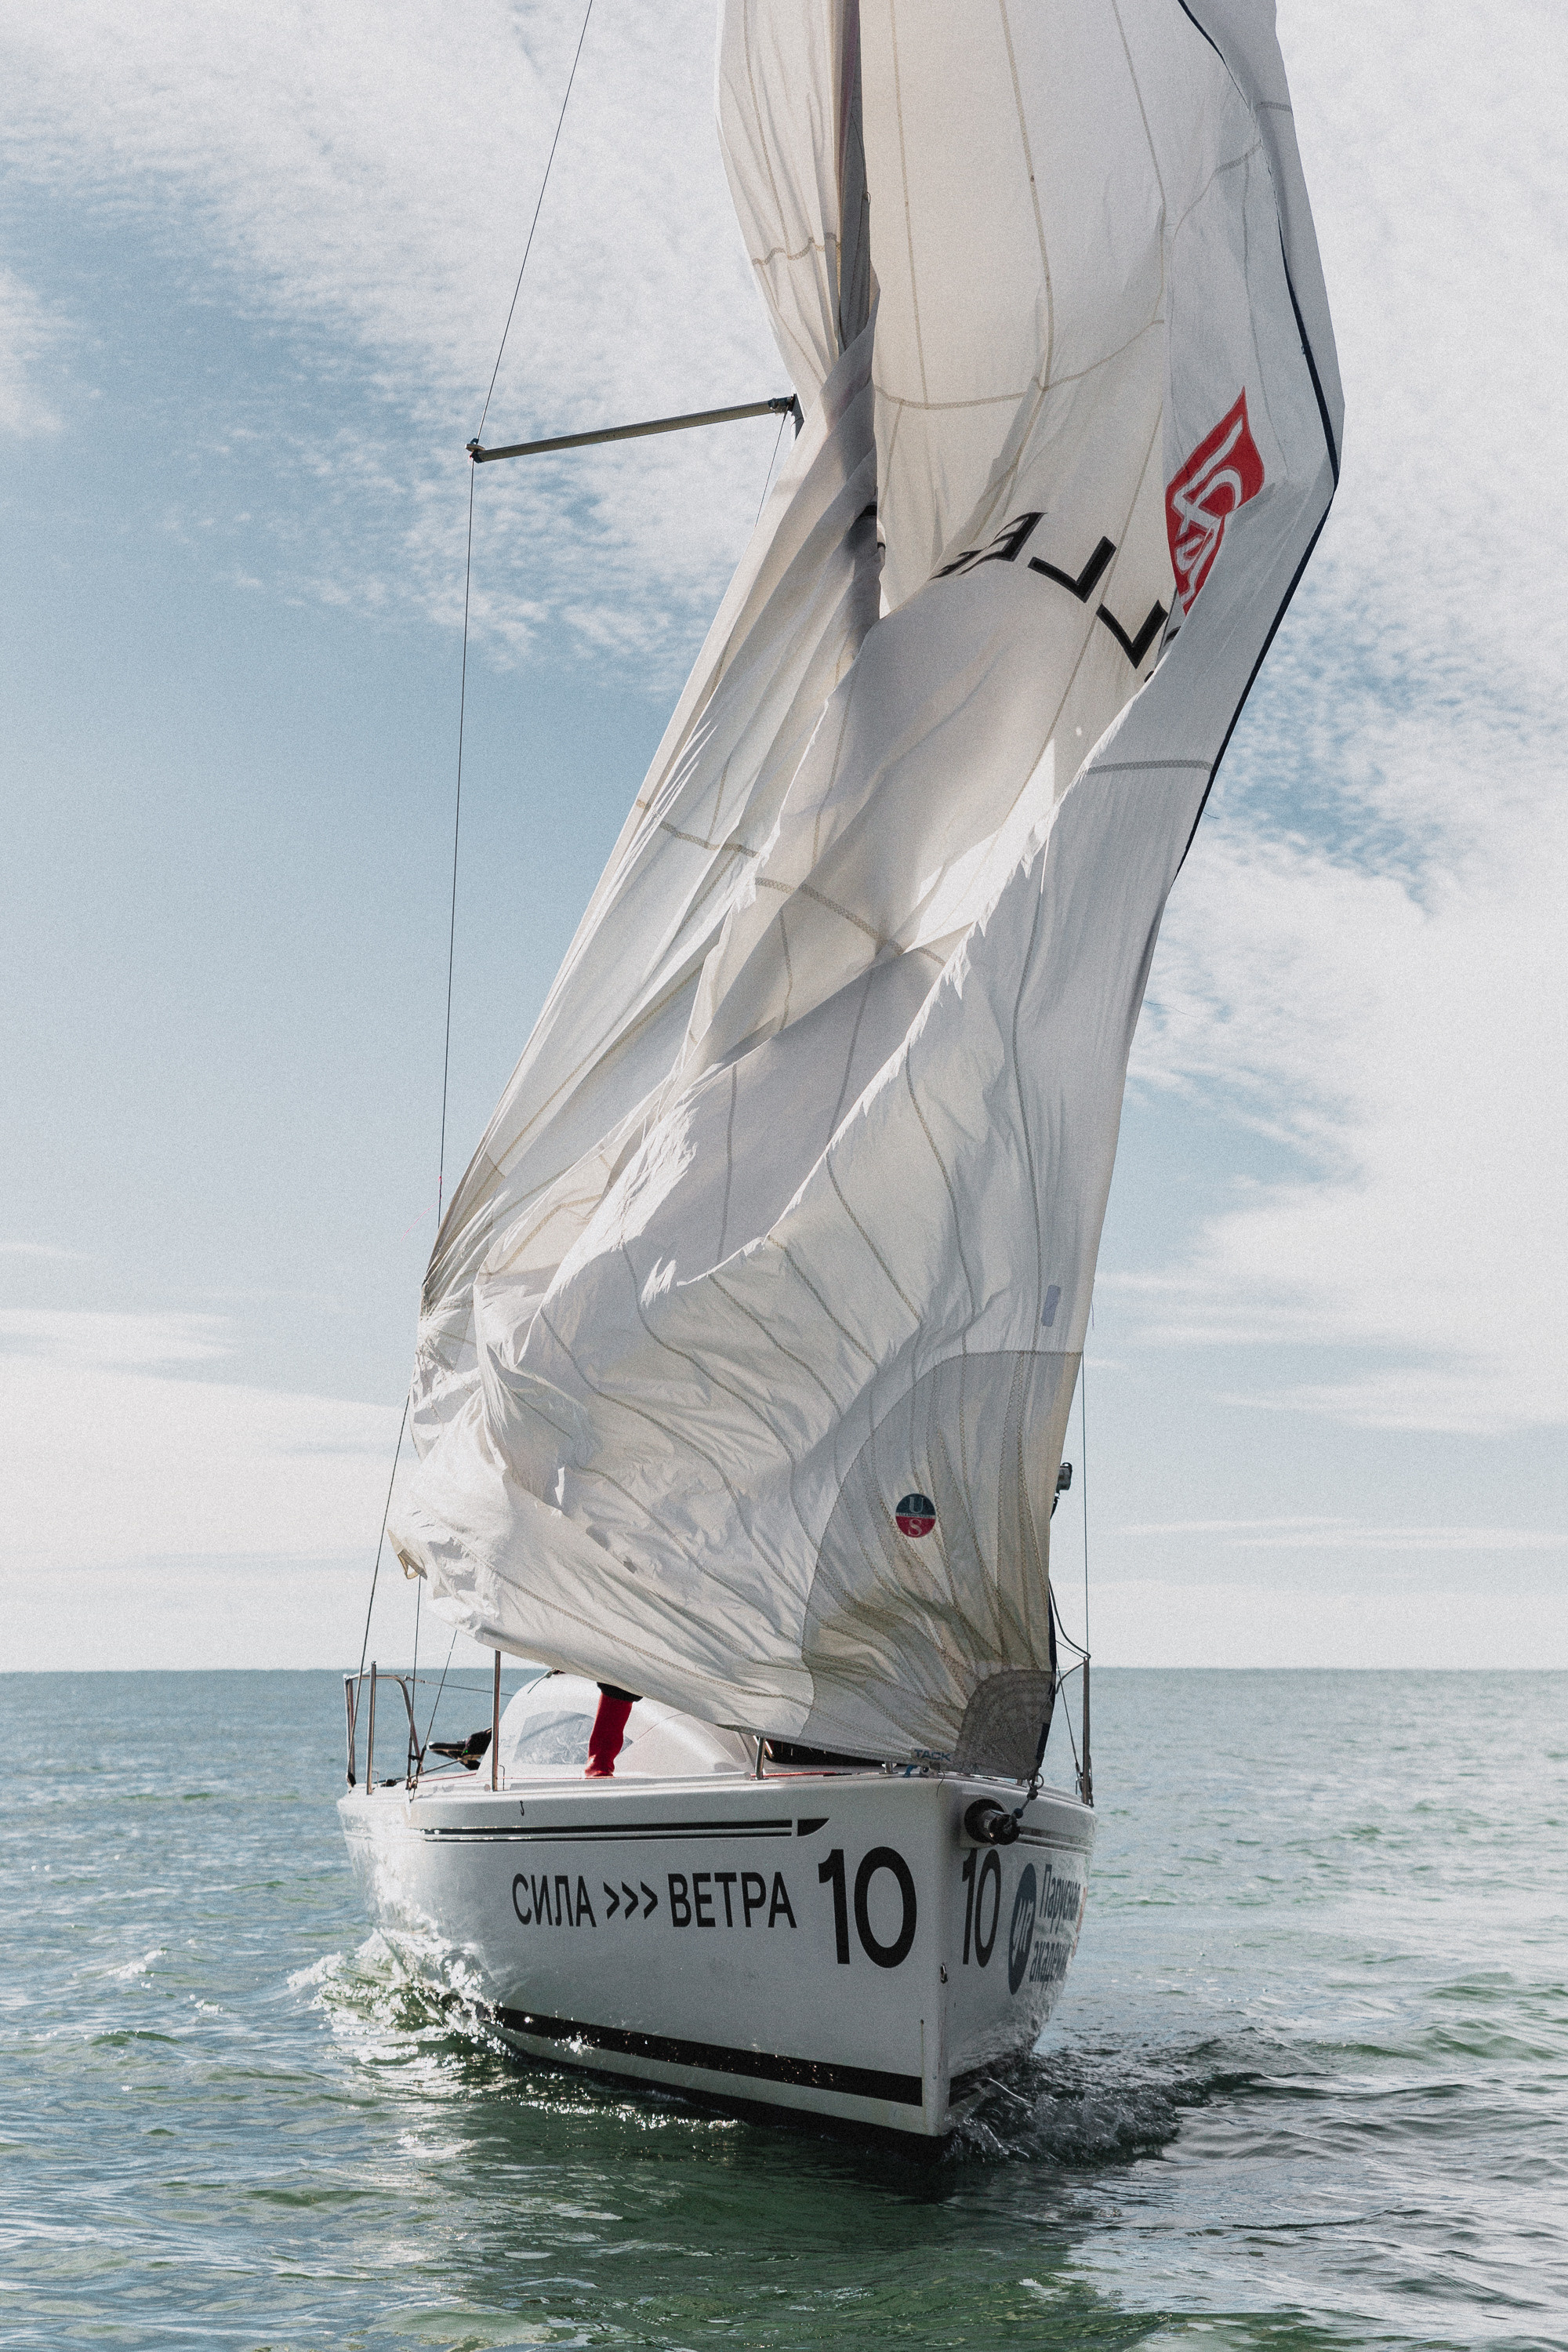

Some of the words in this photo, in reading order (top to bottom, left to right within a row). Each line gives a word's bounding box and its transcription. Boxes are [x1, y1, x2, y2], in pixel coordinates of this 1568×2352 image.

[909, 1496, 924, 1514] U
[908, 1518, 922, 1537] S
[913, 1748, 951, 1762] TACK
[512, 1873, 597, 1928] СИЛА
[667, 1871, 797, 1929] ВЕТРА
[818, 1846, 917, 1969] 10
[961, 1849, 1002, 1969] 10
